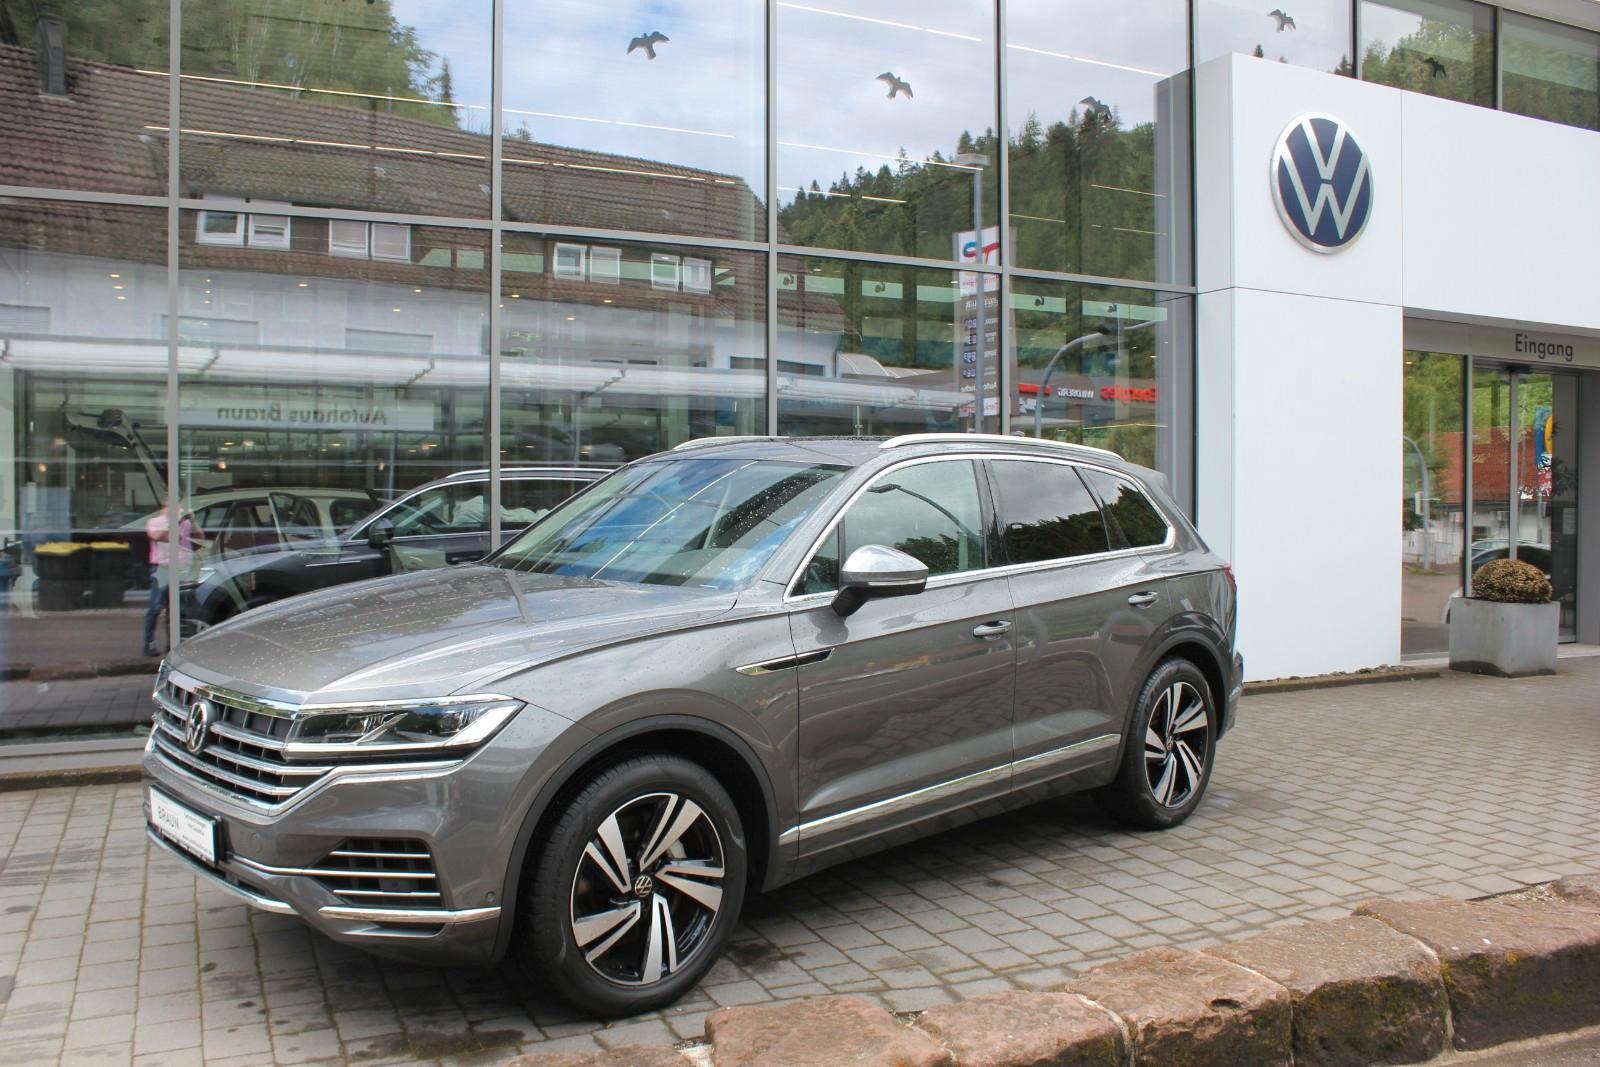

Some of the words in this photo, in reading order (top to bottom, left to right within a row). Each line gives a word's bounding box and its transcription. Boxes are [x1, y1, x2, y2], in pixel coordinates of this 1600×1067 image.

[1272, 114, 1372, 252] VW
[1515, 333, 1573, 362] Eingang
[157, 805, 180, 830] BRAUN
